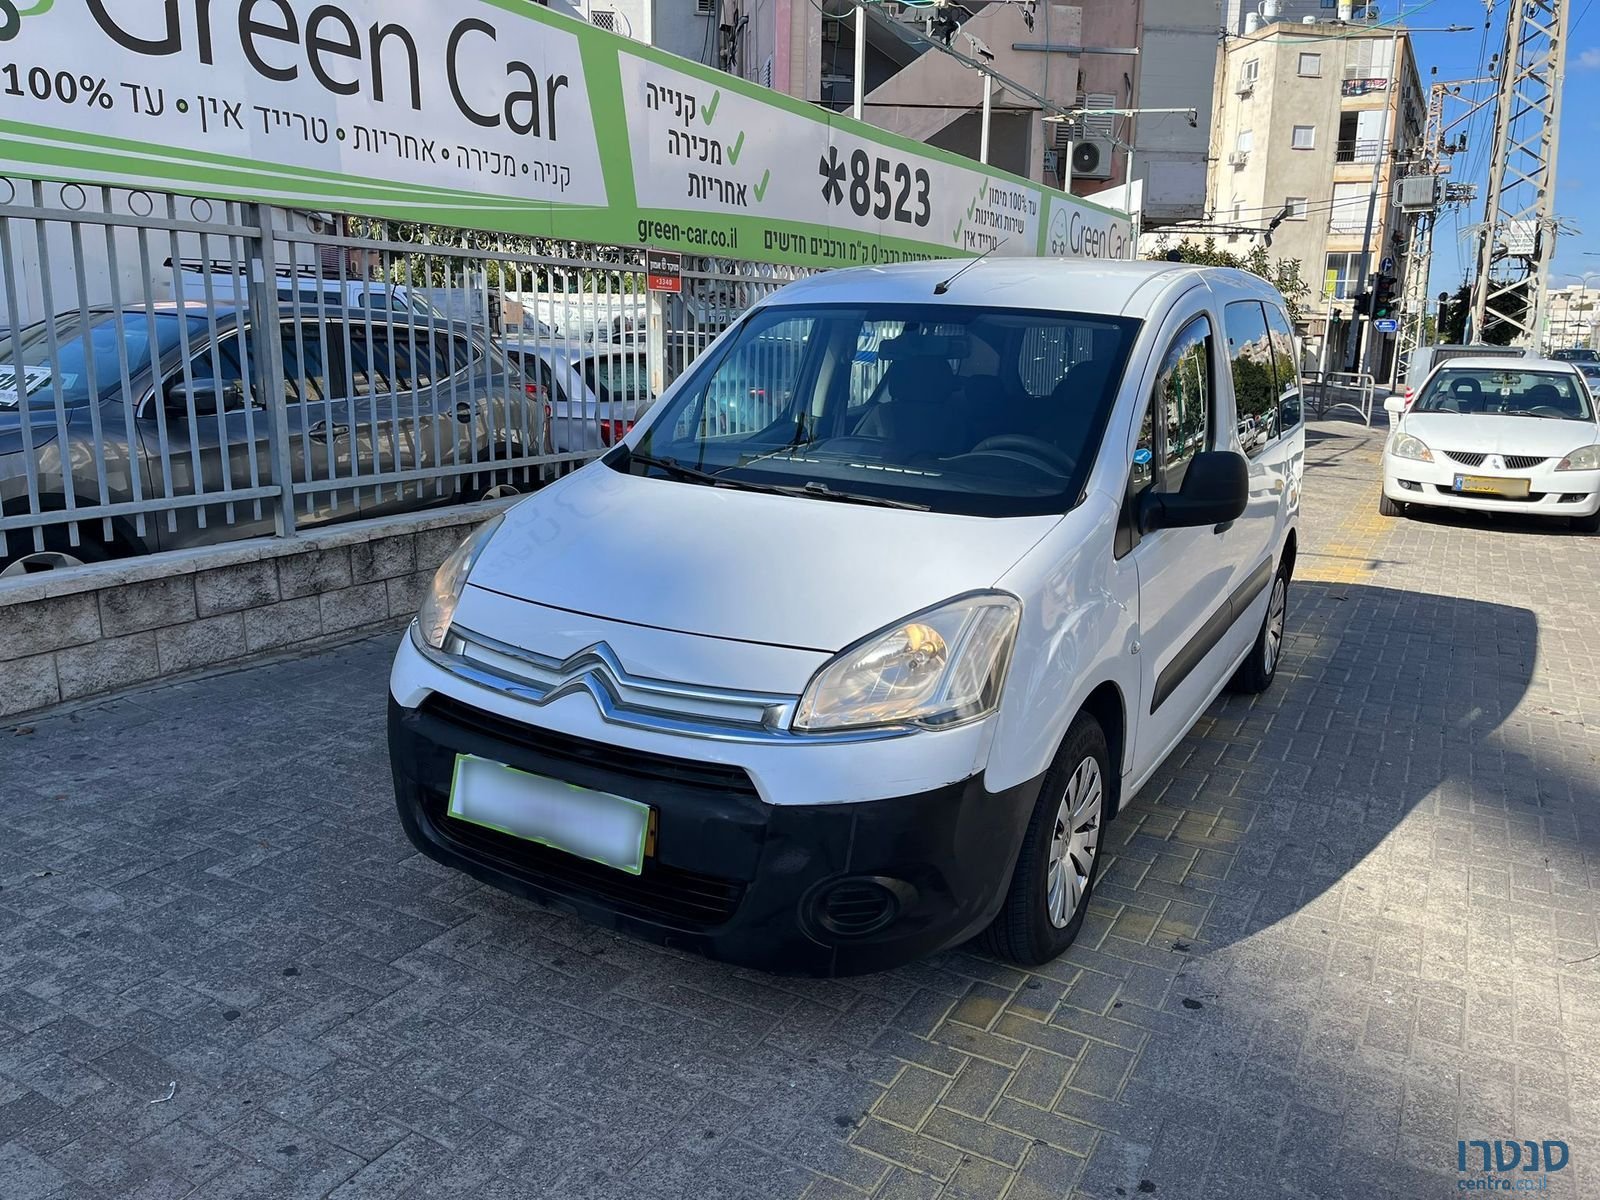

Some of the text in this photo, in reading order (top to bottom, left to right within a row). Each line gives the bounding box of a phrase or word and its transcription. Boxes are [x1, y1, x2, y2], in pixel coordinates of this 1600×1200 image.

[446, 18, 568, 141] Car
[646, 82, 696, 127] קנייה
[1, 63, 571, 192] קניה מכירה אחריות טרייד אין עד 100%
[668, 129, 722, 165] מכירה
[687, 172, 748, 207] אחריות
[988, 186, 1037, 216] עד 100% מימון
[638, 219, 738, 249] green-car.co.il
[974, 207, 1025, 235] שירות ואמינות
[1070, 211, 1127, 260] Green Car
[764, 230, 807, 254] חדשים
[811, 237, 846, 260] ורכבים
[871, 243, 878, 264] 0
[963, 229, 998, 252] טרייד אין
[879, 248, 900, 264] רכבי
